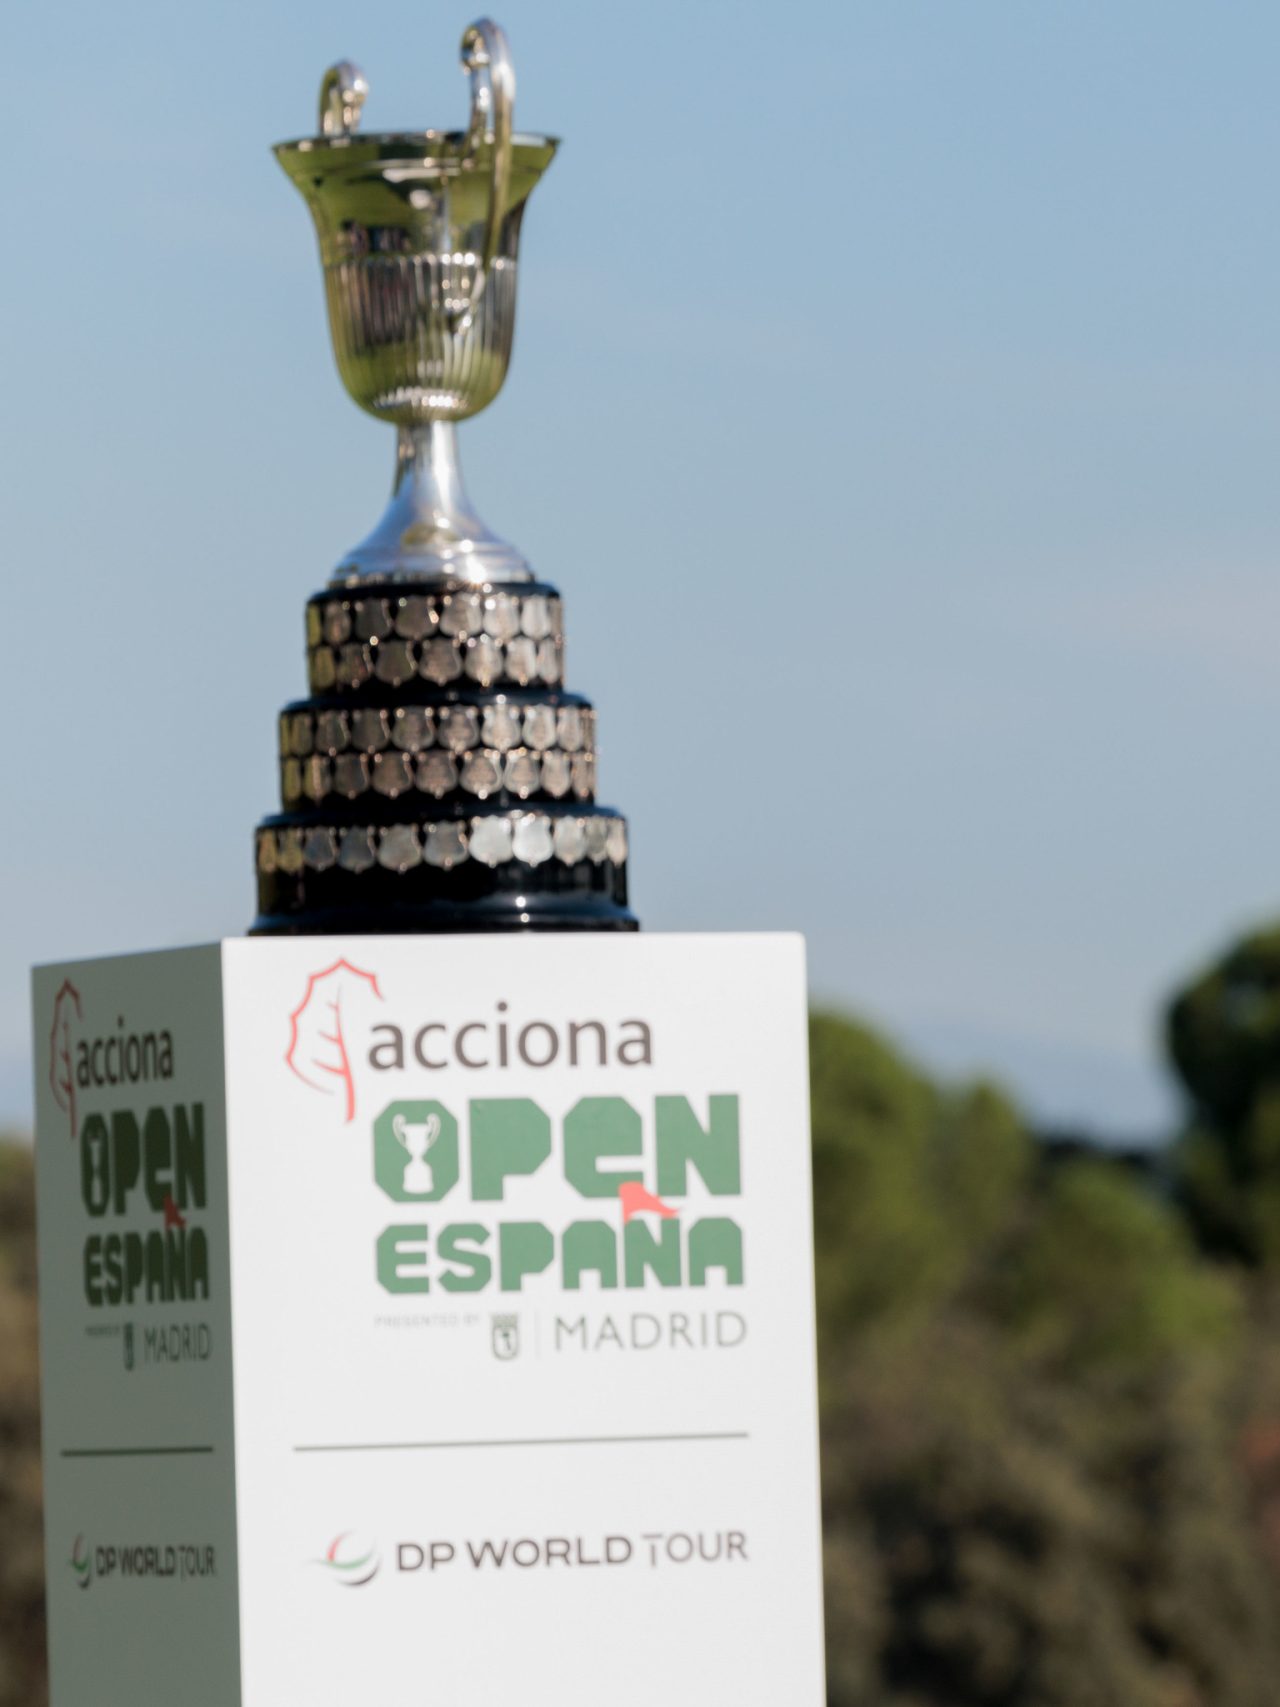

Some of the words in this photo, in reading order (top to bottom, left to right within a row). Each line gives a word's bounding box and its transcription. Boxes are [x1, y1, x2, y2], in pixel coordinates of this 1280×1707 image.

[76, 1014, 175, 1088] acciona
[367, 1000, 654, 1071] acciona
[79, 1101, 208, 1218] OPEN
[372, 1093, 742, 1204] OPEN
[143, 1322, 212, 1364] MADRID
[553, 1310, 748, 1352] MADRID
[95, 1545, 117, 1576] DP
[118, 1544, 176, 1577] WORLD
[177, 1543, 217, 1582] TOUR
[396, 1541, 455, 1572] DP
[465, 1535, 633, 1570] WORLD
[640, 1530, 750, 1569] TOUR
